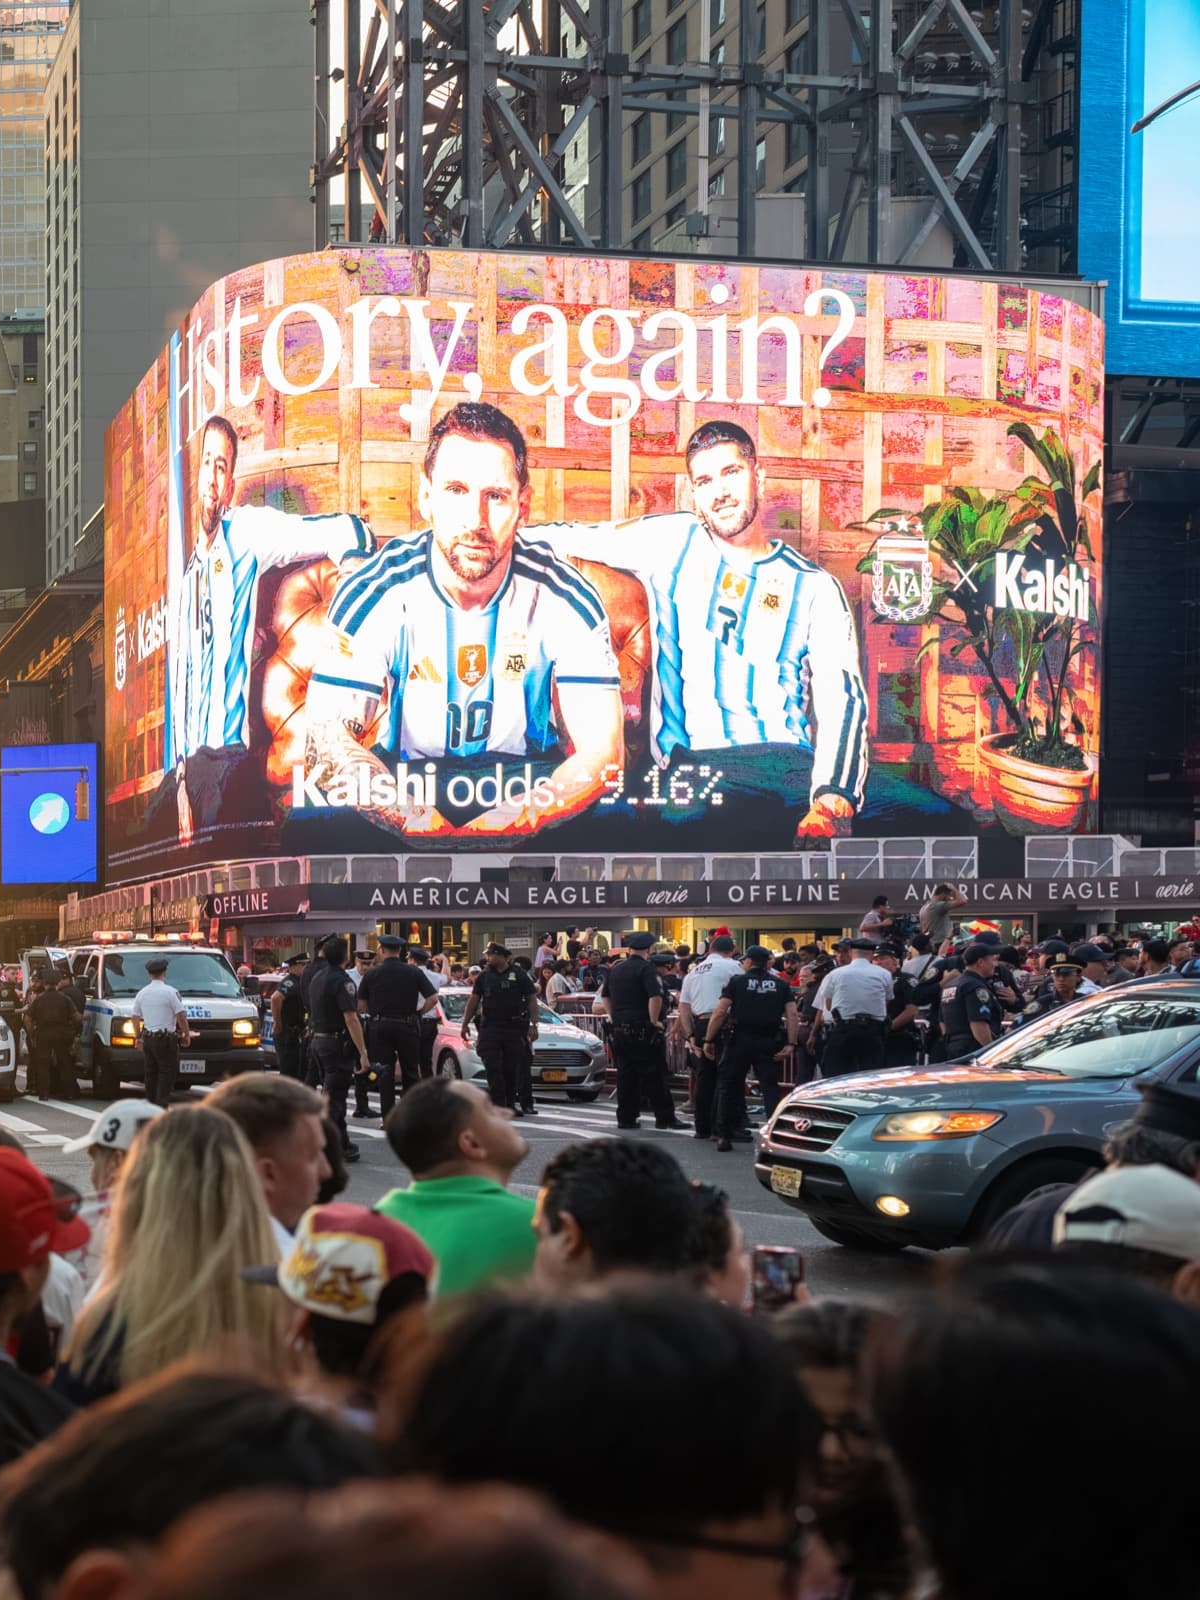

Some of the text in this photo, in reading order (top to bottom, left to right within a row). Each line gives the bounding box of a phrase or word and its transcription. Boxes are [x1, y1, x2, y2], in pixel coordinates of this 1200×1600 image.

[171, 284, 857, 456] History, again?
[995, 552, 1090, 622] Kalshi
[447, 701, 494, 750] 10
[292, 762, 724, 808] Kalshi odds: 9.16%
[213, 892, 269, 915] OFFLINE
[369, 879, 1195, 906] AMERICAN EAGLE aerie OFFLINE AMRICAN EAGLE aerie
[184, 1010, 212, 1018] LICE
[103, 1118, 121, 1142] 3
